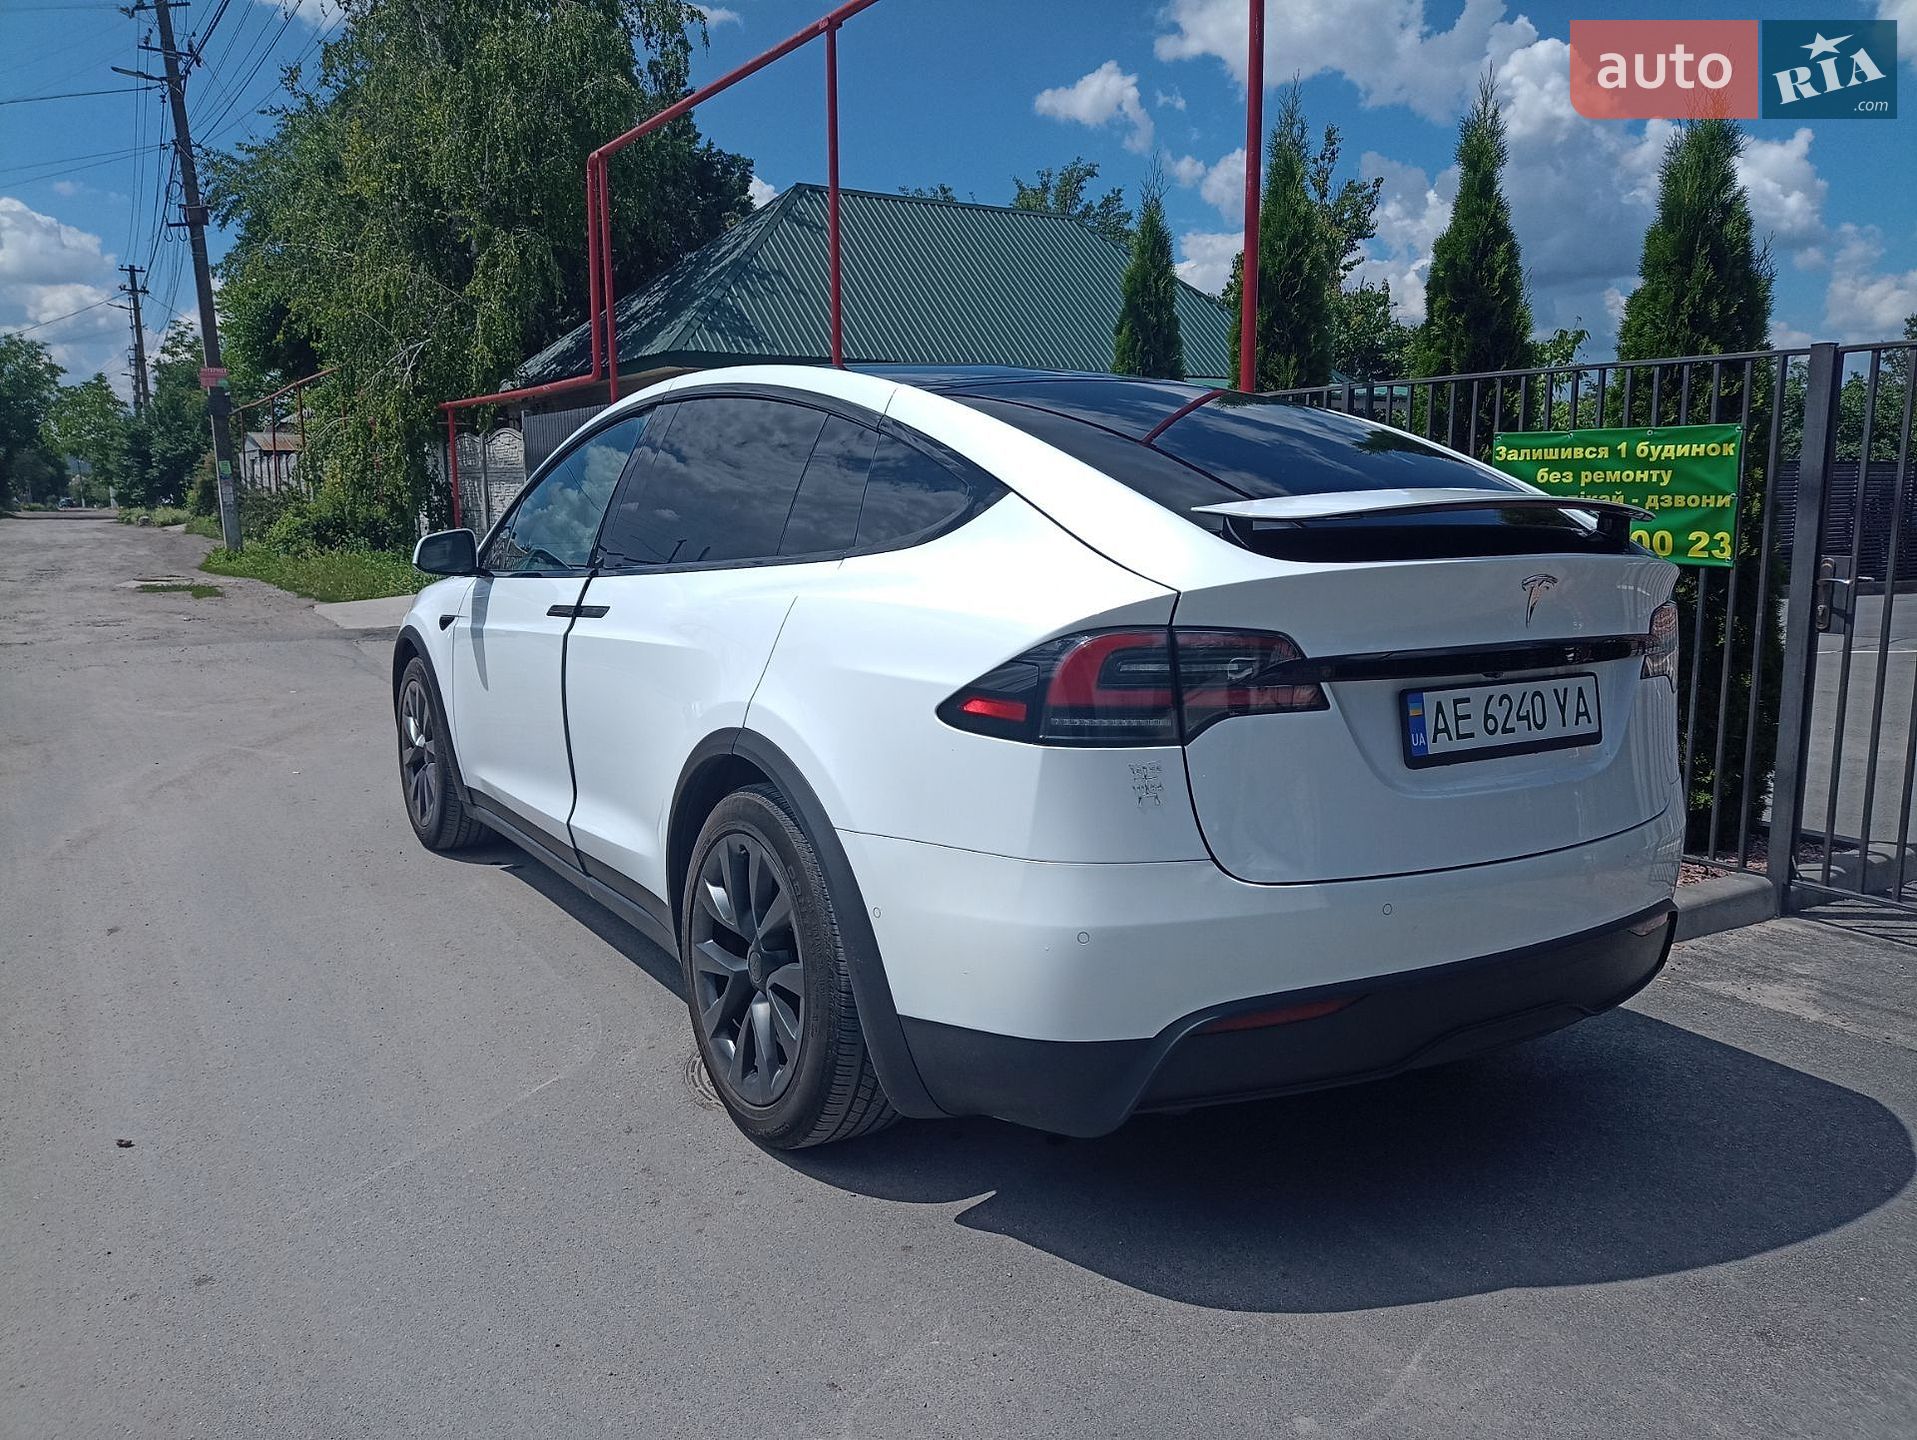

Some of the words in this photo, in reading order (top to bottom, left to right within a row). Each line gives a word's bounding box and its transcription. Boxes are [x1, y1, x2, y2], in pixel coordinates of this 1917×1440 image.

[1495, 444, 1609, 461] Залишився
[1617, 441, 1628, 458] 1
[1636, 441, 1735, 459] будинок
[1536, 467, 1574, 484] без
[1581, 467, 1673, 486] ремонту
[1645, 494, 1732, 510] дзвони
[1687, 530, 1732, 560] 23
[1431, 697, 1476, 744] AE
[1483, 689, 1548, 736] 6240
[1553, 686, 1593, 728] YA
[1411, 732, 1427, 748] UA
